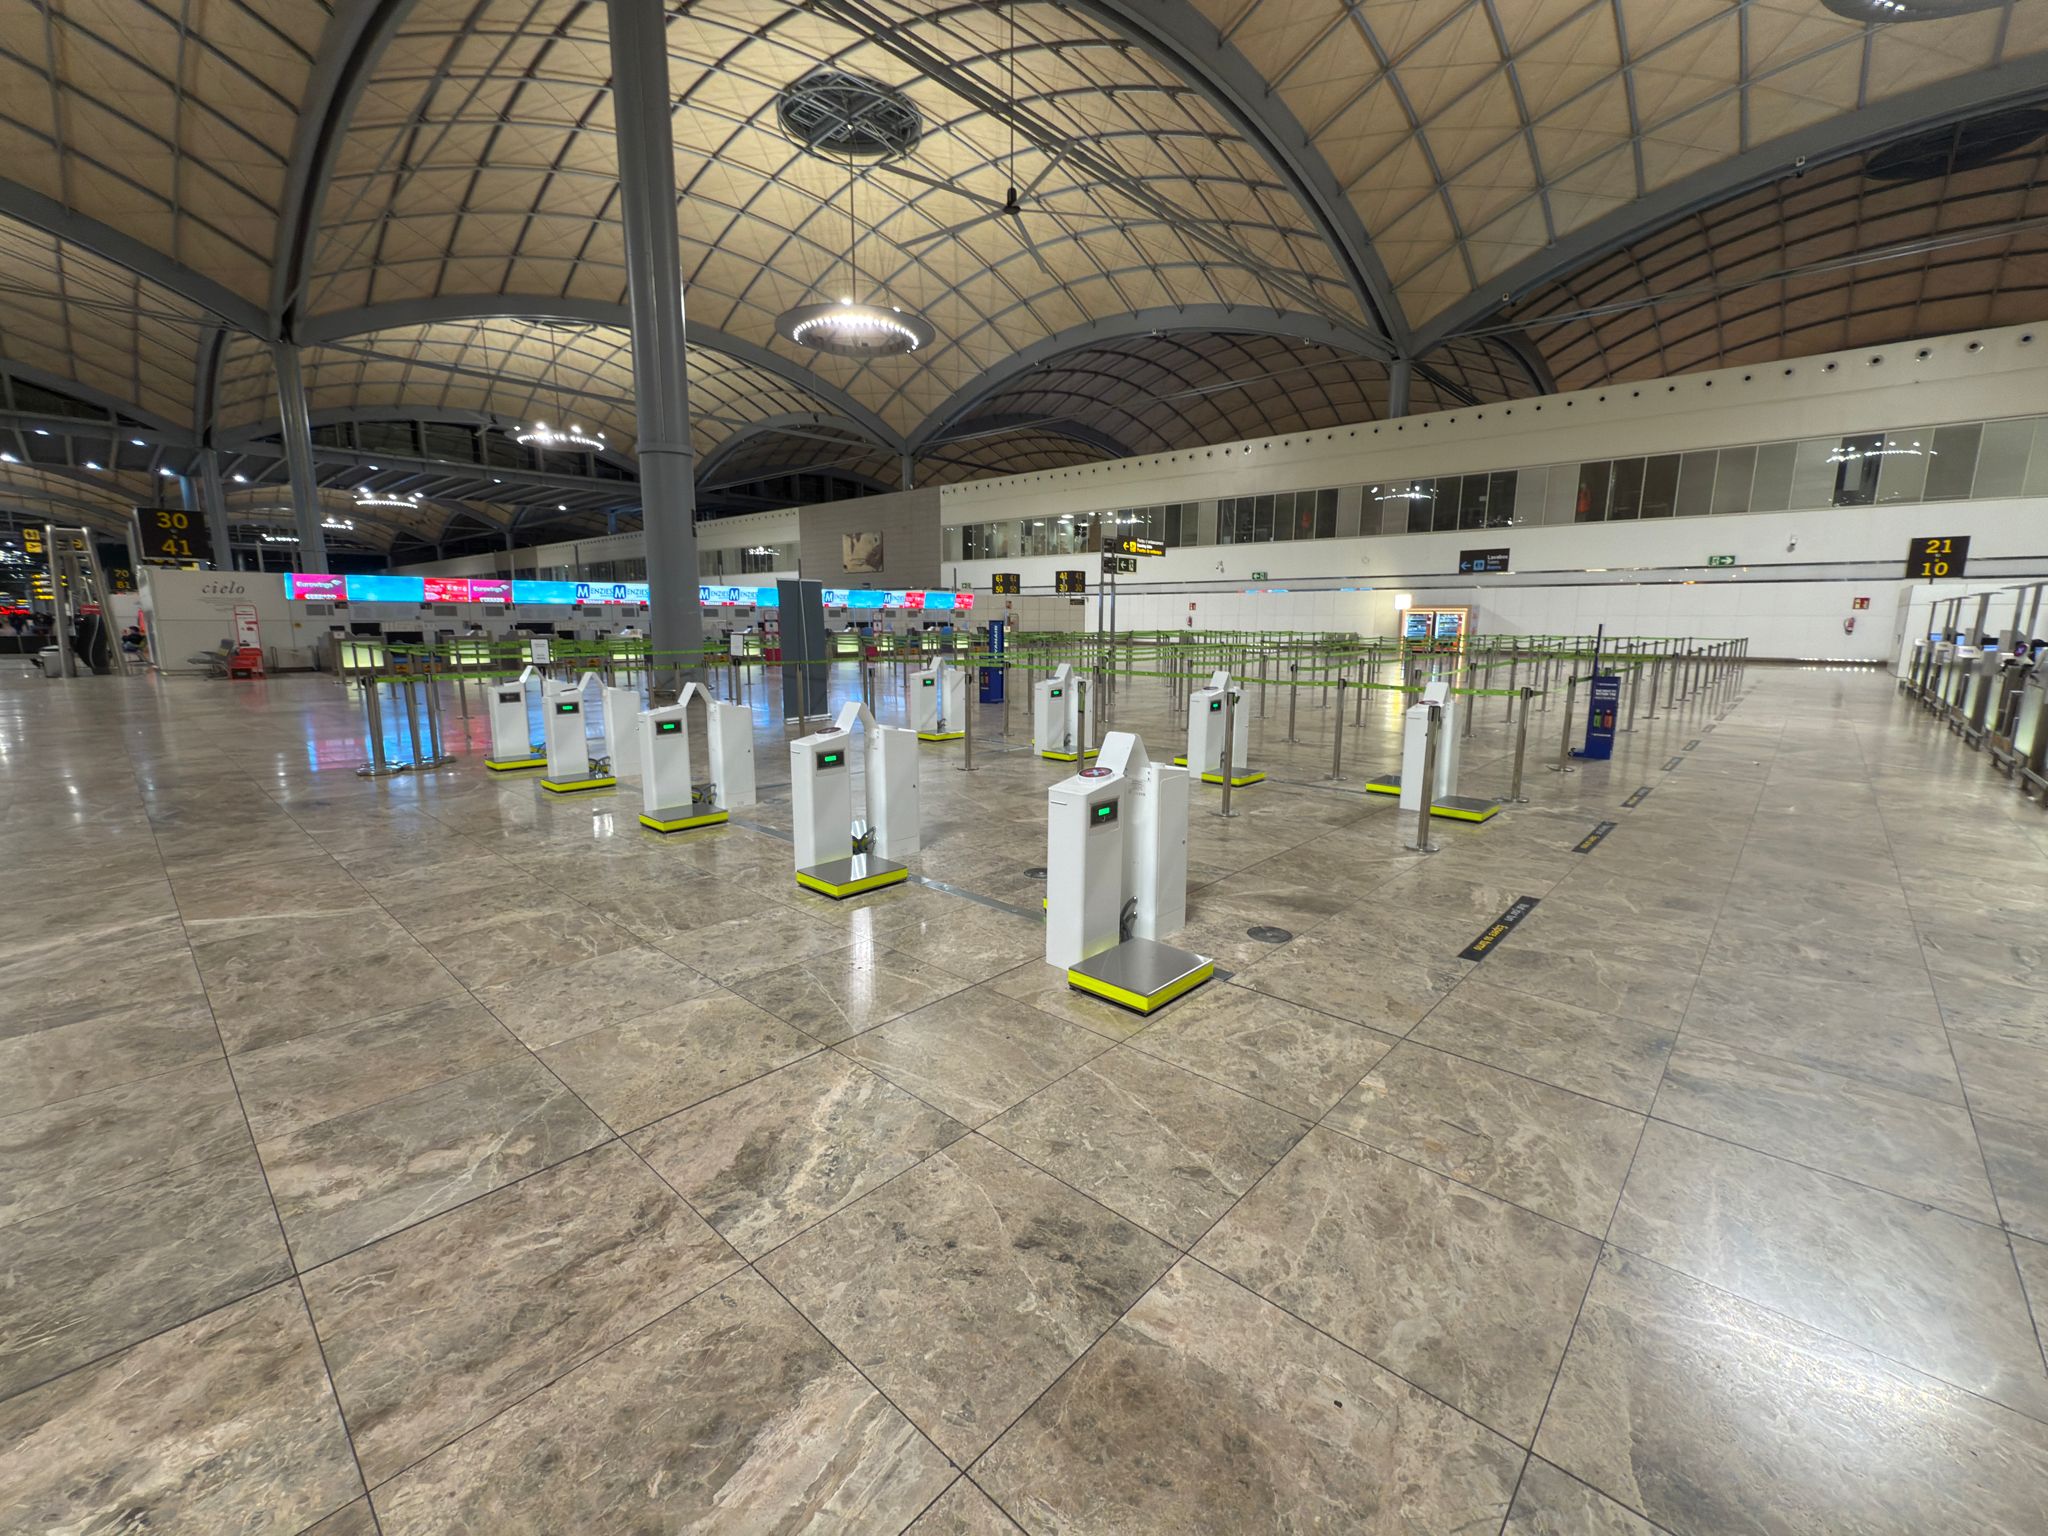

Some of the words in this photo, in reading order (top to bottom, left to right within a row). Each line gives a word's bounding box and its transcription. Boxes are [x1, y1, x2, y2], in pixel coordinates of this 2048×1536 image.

[157, 512, 189, 529] 30
[162, 540, 192, 555] 41
[1925, 539, 1952, 554] 21
[1921, 562, 1949, 576] 10
[202, 581, 245, 594] ciclo
